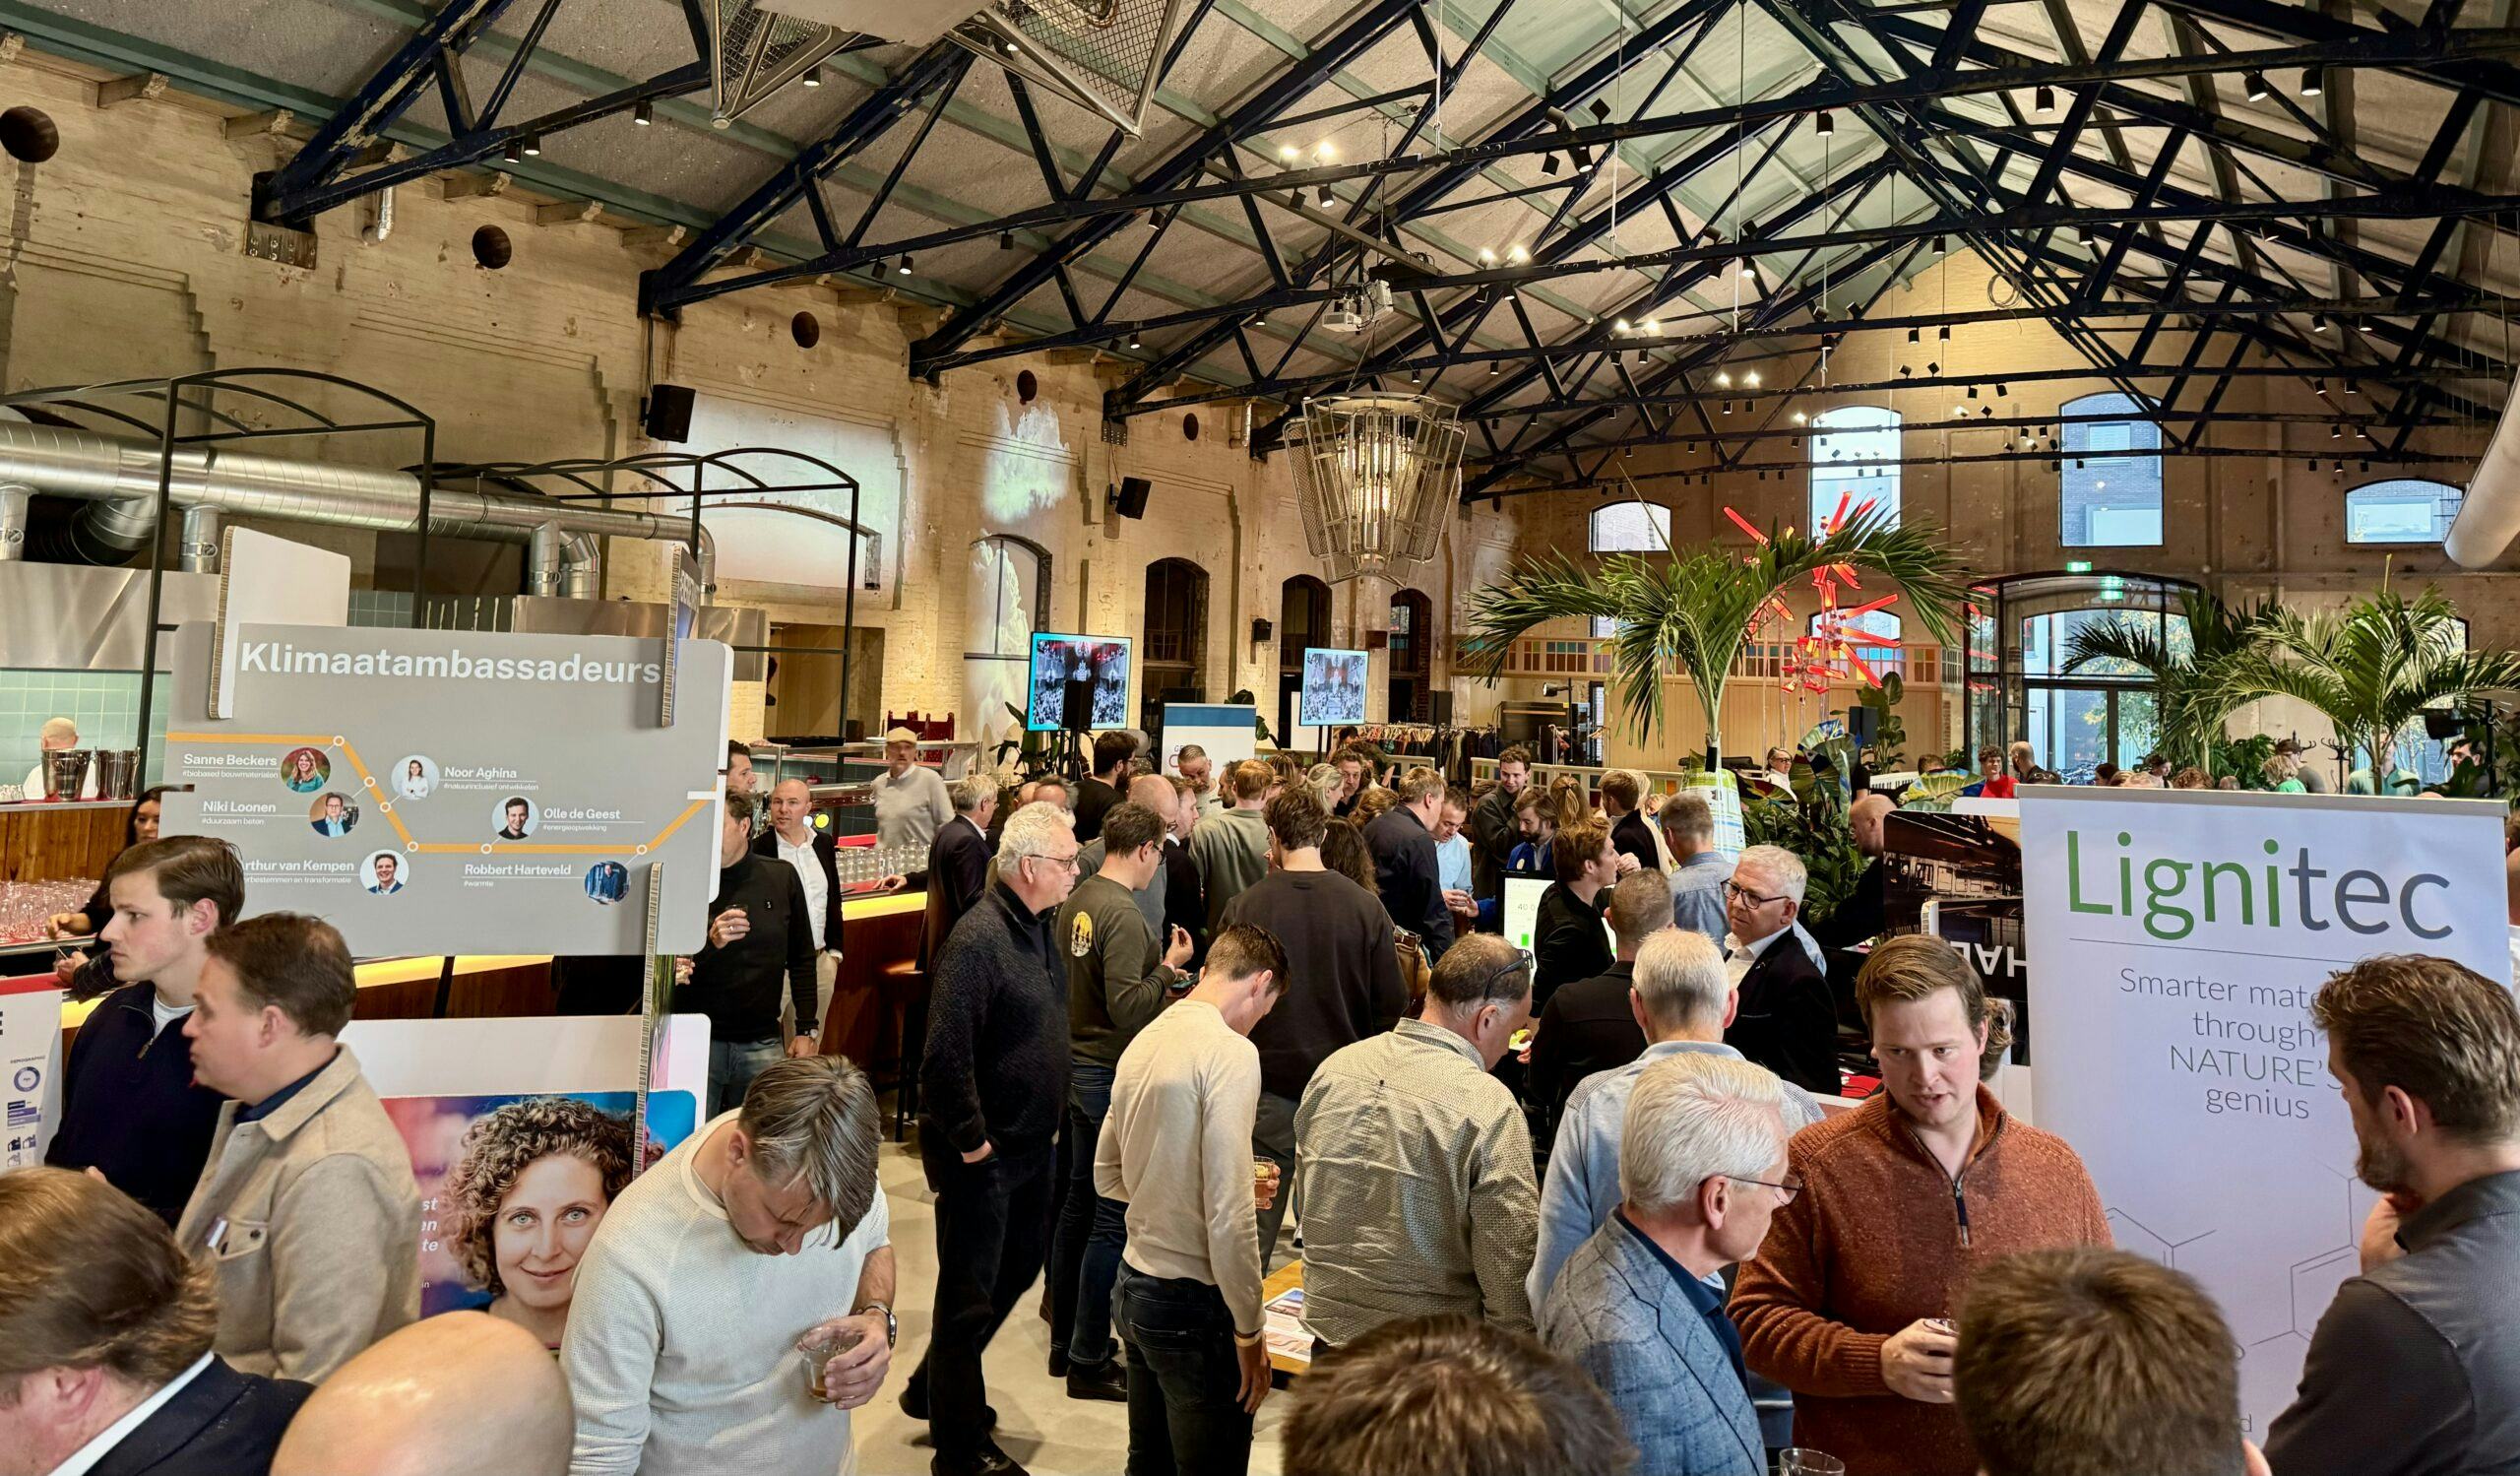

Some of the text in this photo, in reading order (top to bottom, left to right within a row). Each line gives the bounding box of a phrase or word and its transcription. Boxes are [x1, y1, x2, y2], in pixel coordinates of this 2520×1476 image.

[240, 642, 662, 684] Klimaatambassadeurs
[183, 753, 278, 766] Sanne Beckers
[445, 766, 517, 780] Noor Aghina
[203, 801, 277, 812] Niki Loonen
[543, 807, 621, 819] Olle de Geest
[279, 862, 301, 871] van
[302, 860, 354, 873] Kempen
[465, 864, 571, 875] Robbert Harteveld
[2067, 830, 2453, 939] Lignitec
[2119, 968, 2238, 1001] Smarter
[2192, 1011, 2315, 1051] through
[2206, 1088, 2309, 1119] genius
